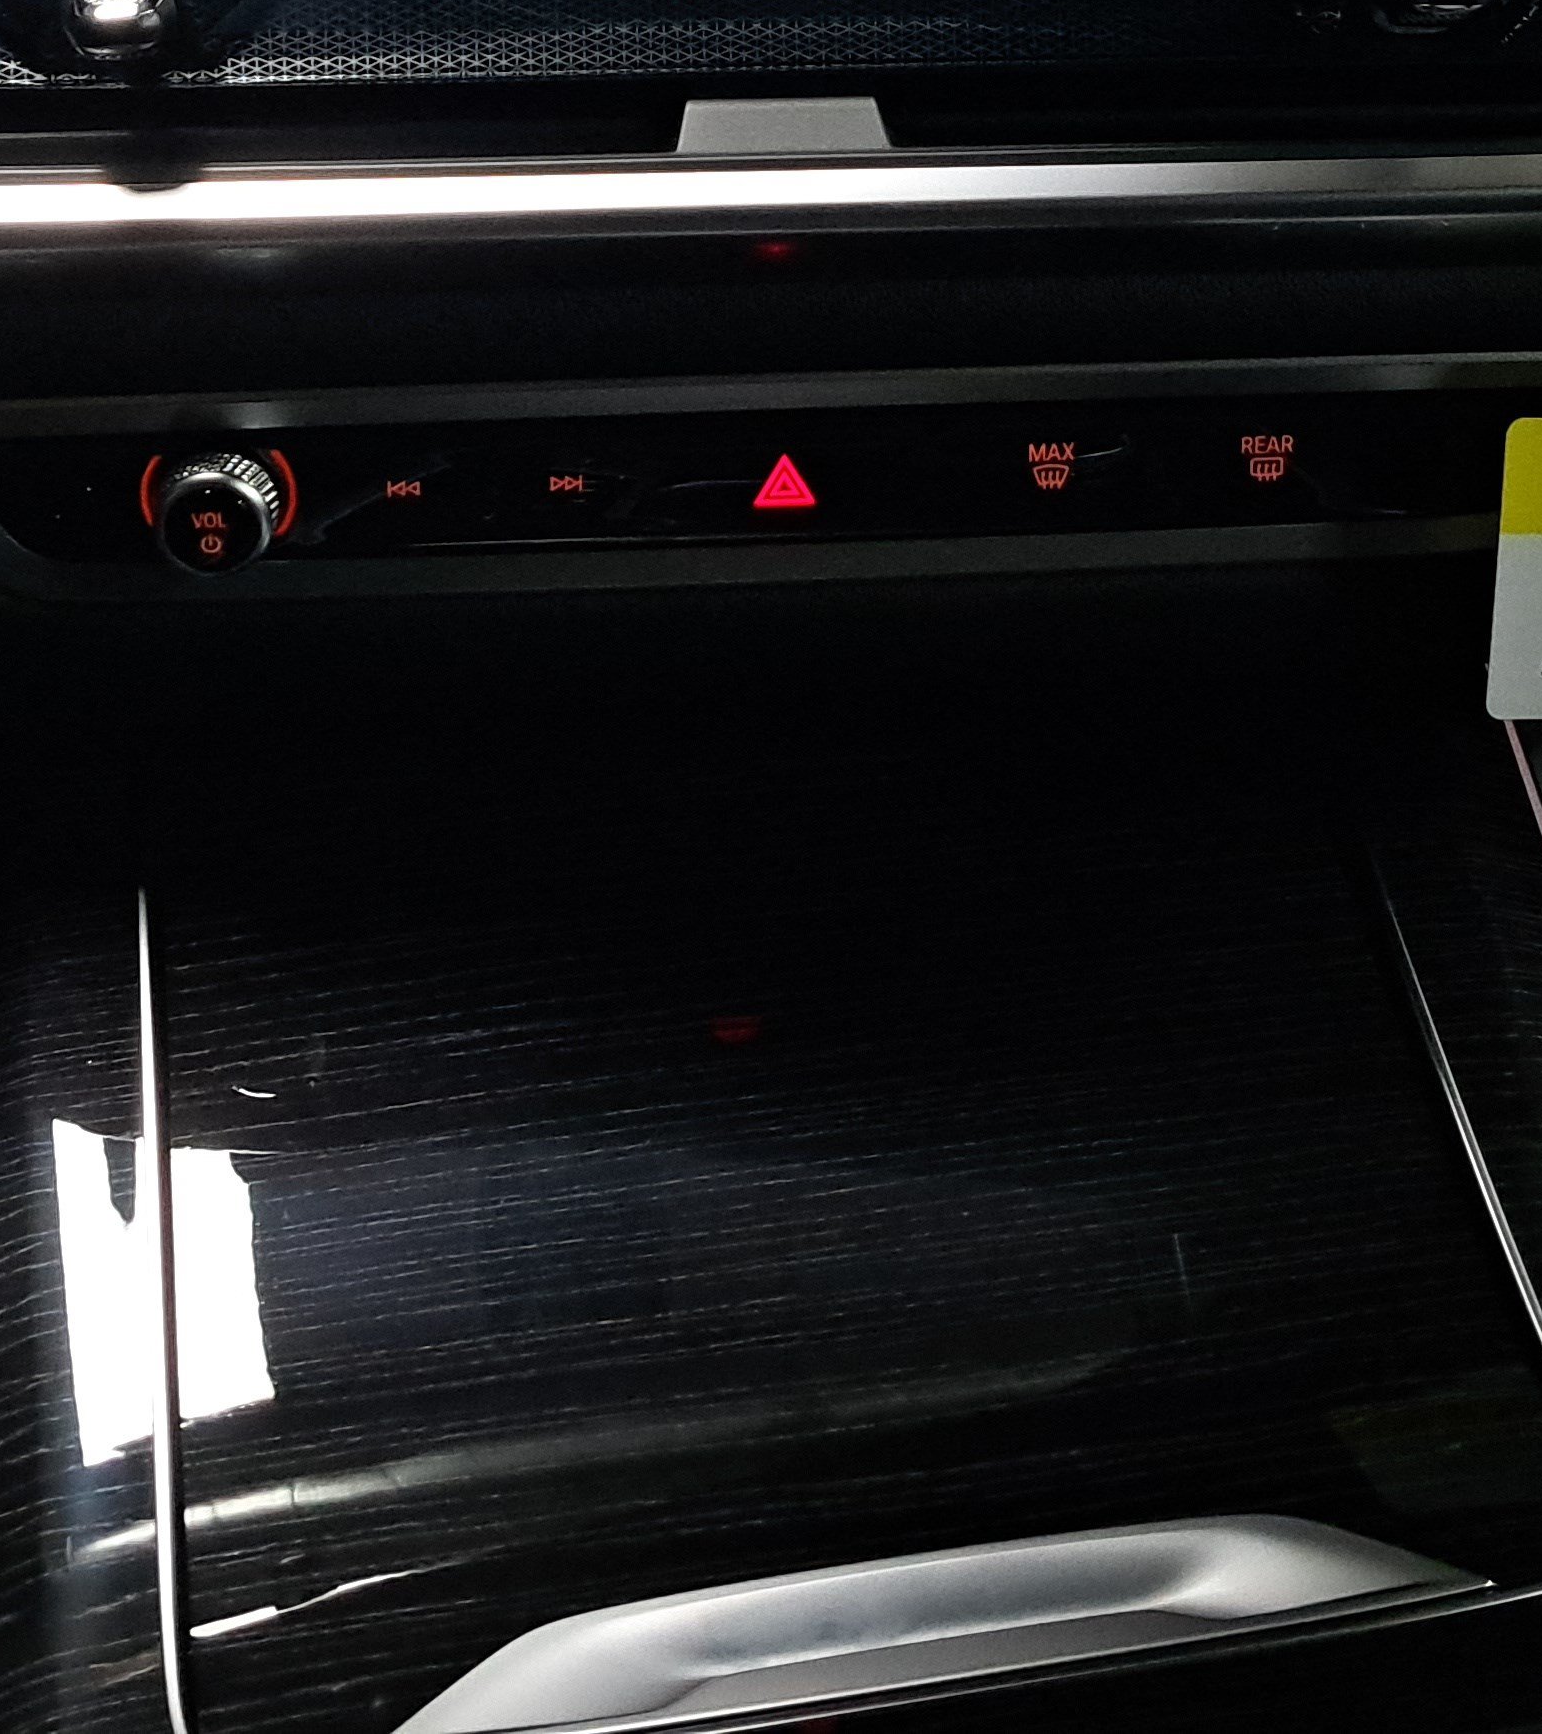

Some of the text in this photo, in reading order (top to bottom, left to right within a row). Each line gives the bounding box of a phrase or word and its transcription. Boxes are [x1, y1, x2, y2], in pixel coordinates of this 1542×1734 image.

[1028, 442, 1075, 463] MAX
[1241, 434, 1295, 455] REAR
[191, 512, 227, 529] VOL
